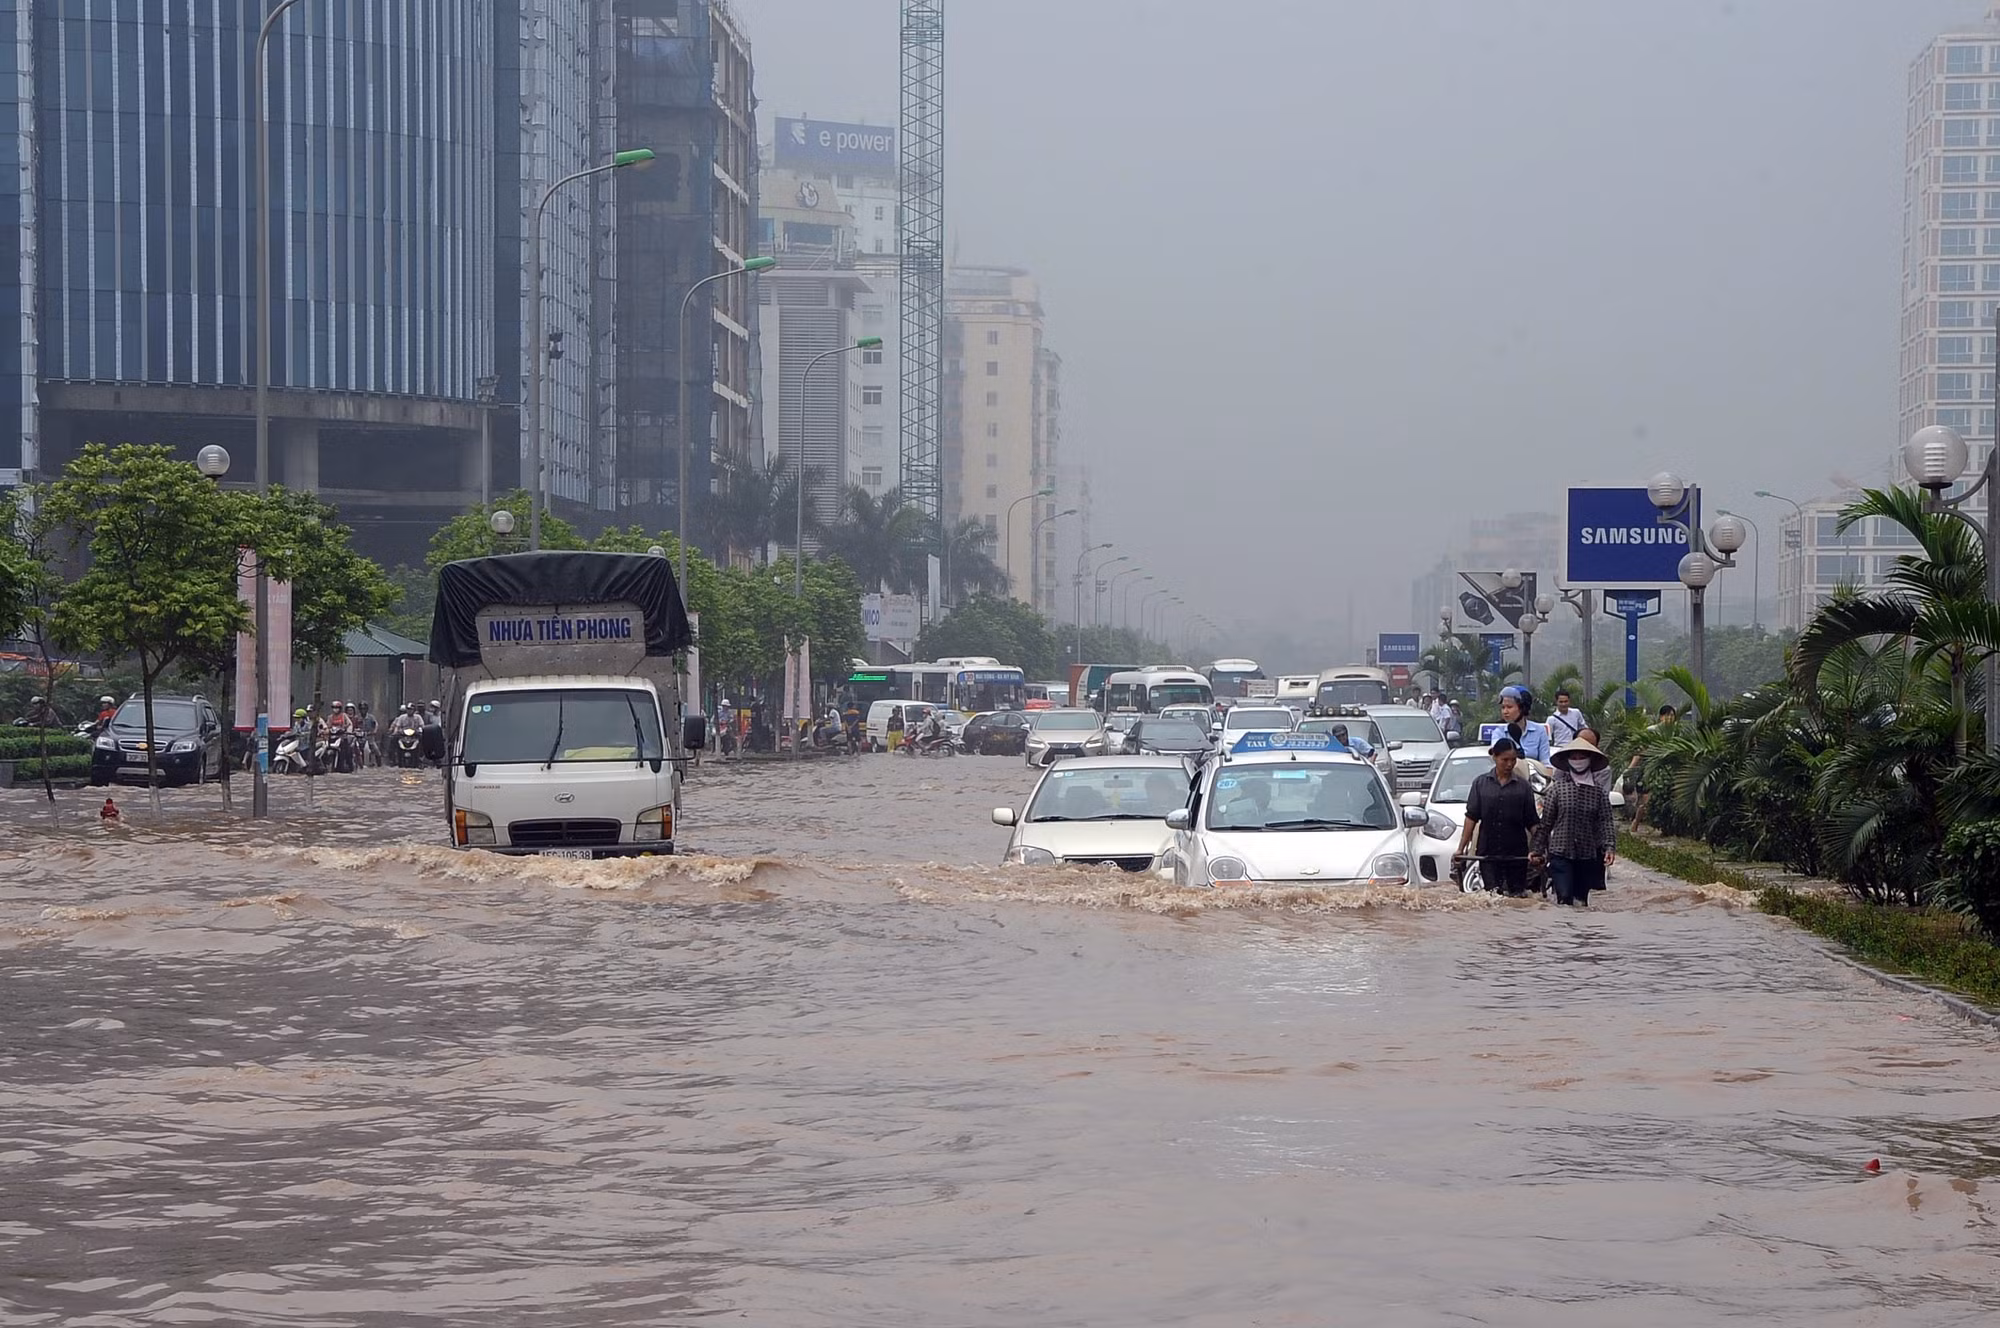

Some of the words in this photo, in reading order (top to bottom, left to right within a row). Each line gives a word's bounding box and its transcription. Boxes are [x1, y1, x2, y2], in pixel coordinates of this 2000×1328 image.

[819, 130, 831, 147] e
[837, 132, 892, 153] power
[1581, 527, 1687, 544] SAMSUNG
[576, 617, 631, 640] PHONG
[1247, 740, 1266, 748] TAXI
